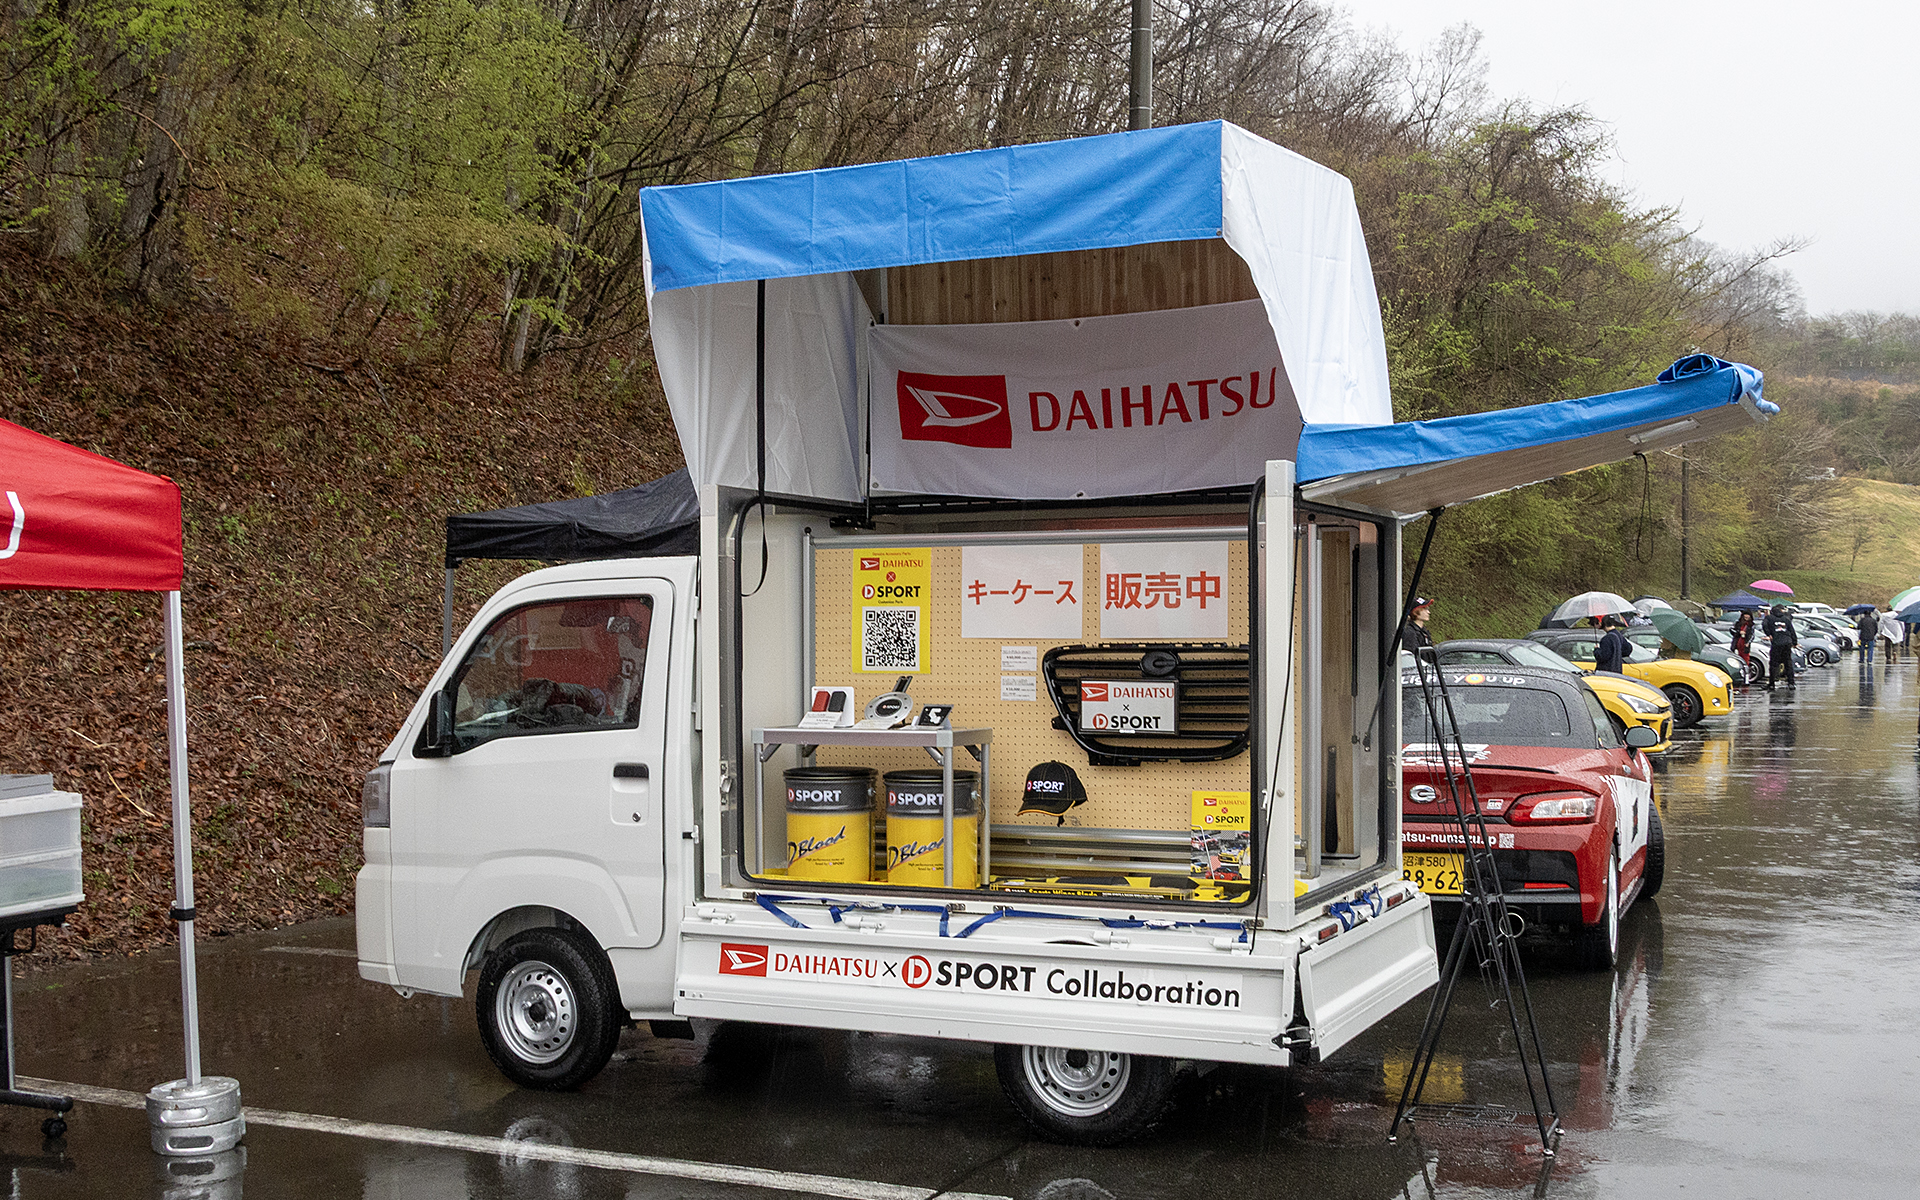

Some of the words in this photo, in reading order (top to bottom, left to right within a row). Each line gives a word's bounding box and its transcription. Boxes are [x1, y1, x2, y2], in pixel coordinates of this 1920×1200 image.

[1029, 367, 1277, 432] DAIHATSU
[882, 560, 923, 568] DAIHATSU
[877, 586, 920, 598] SPORT
[967, 579, 1077, 605] キーケース
[1104, 570, 1220, 610] 販売中
[1400, 674, 1446, 685] Ligh
[1502, 676, 1526, 686] up
[1113, 688, 1174, 698] DAIHATSU
[1110, 716, 1160, 728] SPORT
[1032, 780, 1064, 791] SPORT
[796, 790, 842, 802] SPORT
[775, 954, 878, 978] DAIHATSU
[936, 960, 1036, 992] SPORT
[1046, 968, 1240, 1008] Collaboration
